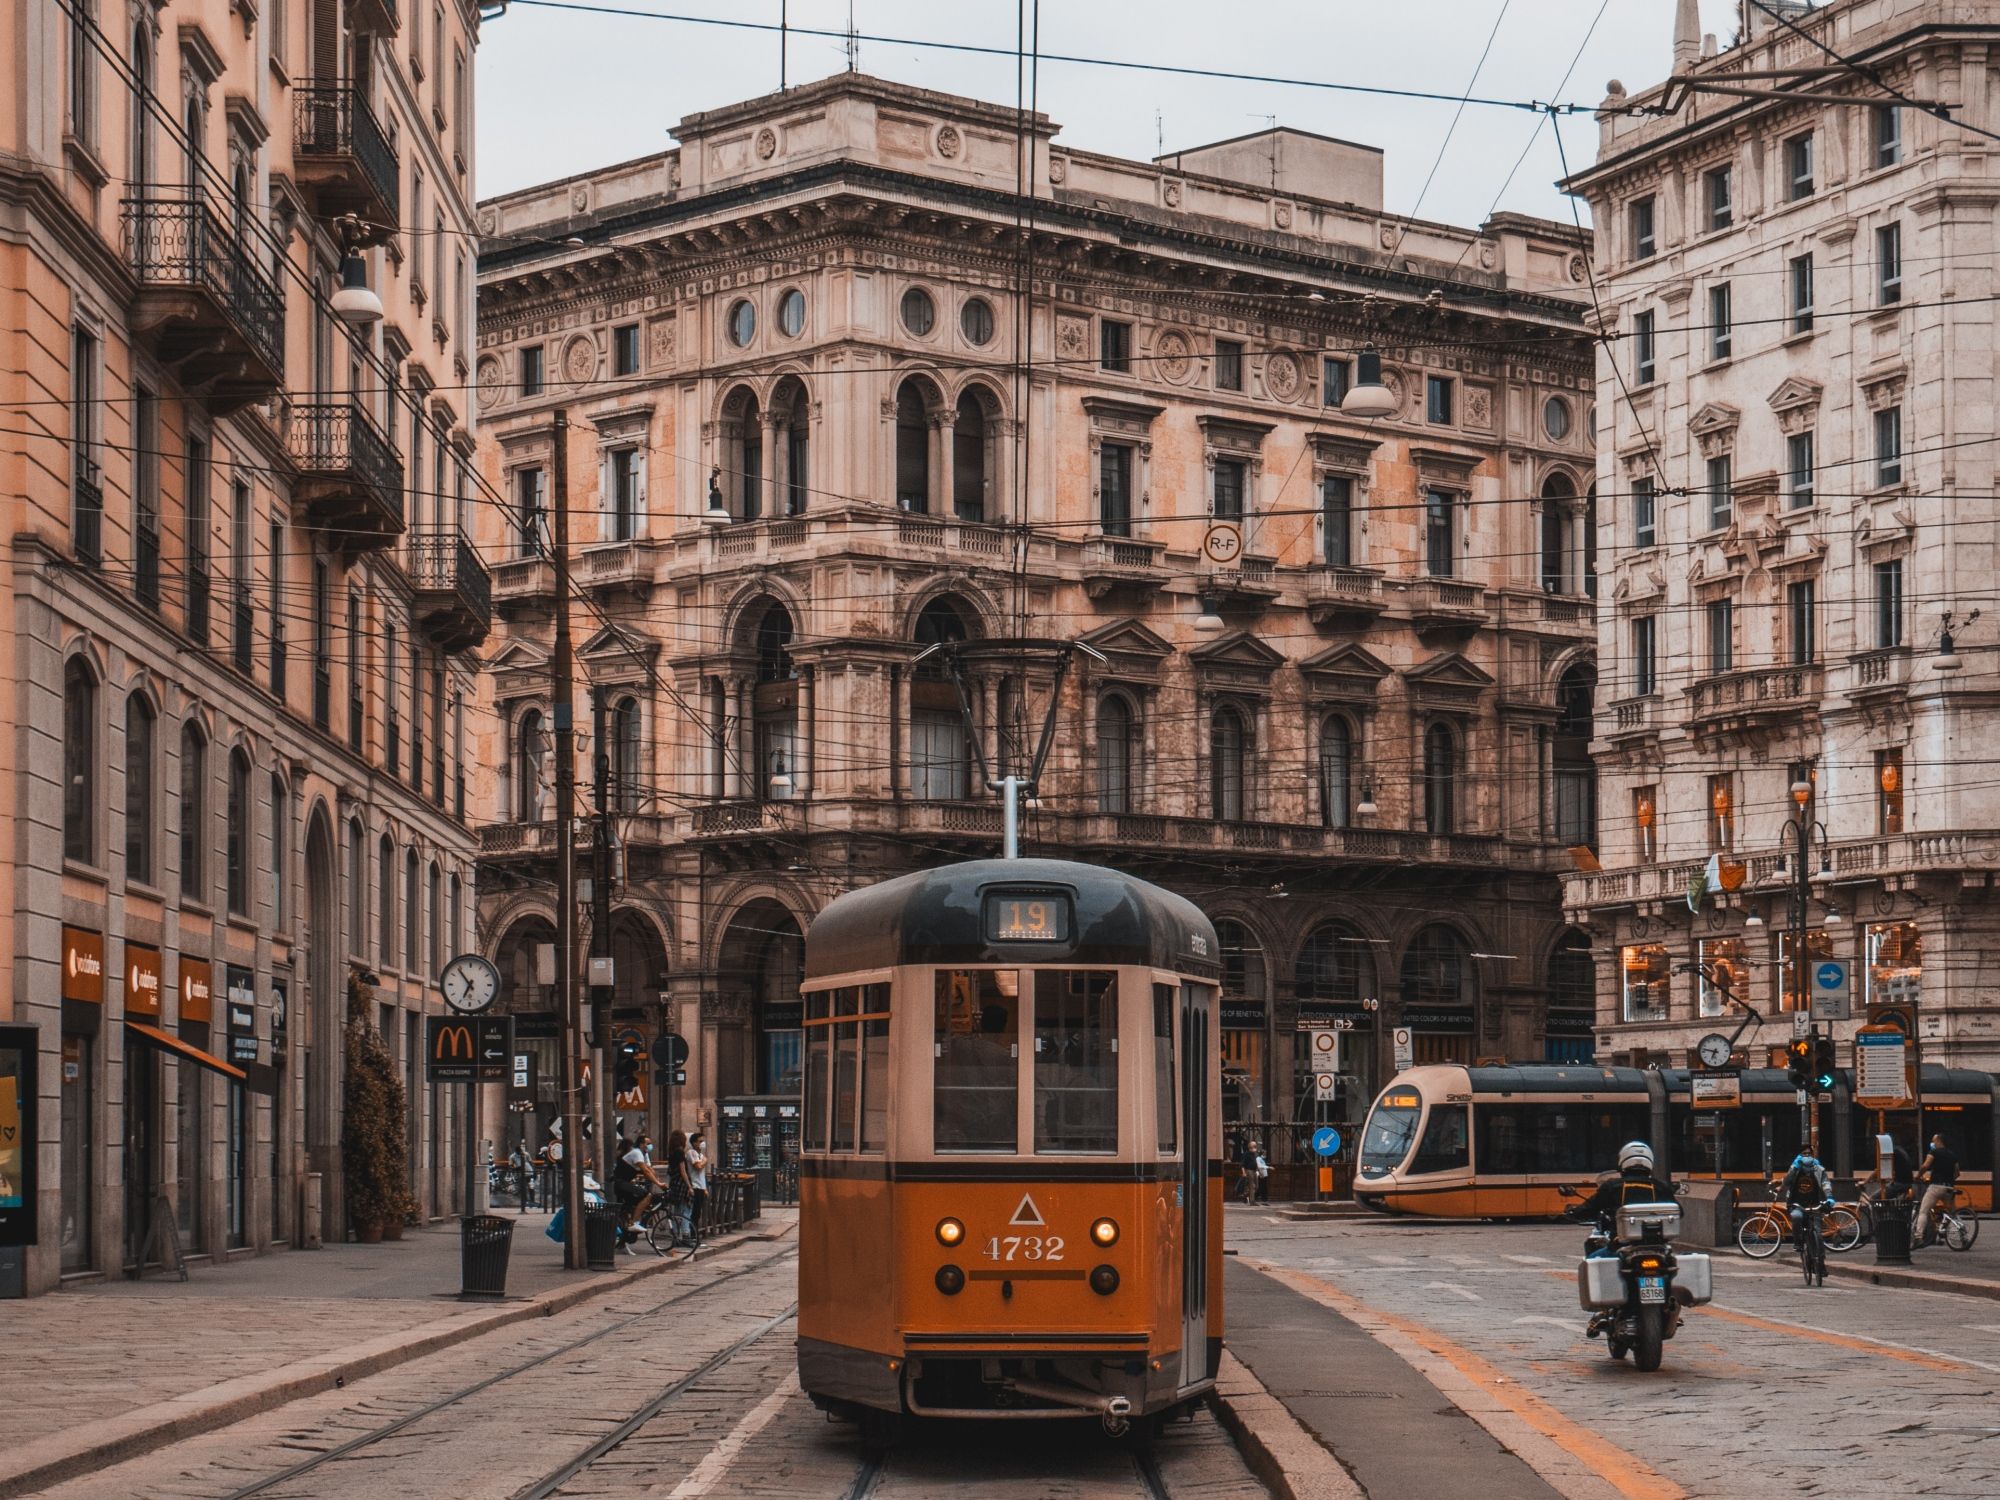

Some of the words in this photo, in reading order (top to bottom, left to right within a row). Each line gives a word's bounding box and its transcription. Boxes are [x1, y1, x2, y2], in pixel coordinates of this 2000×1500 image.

[1210, 537, 1236, 551] R-F
[1010, 901, 1046, 931] 19
[77, 953, 100, 976] vodafone
[139, 969, 158, 990] vodafone
[191, 979, 209, 999] vodafone
[982, 1236, 1064, 1261] 4732
